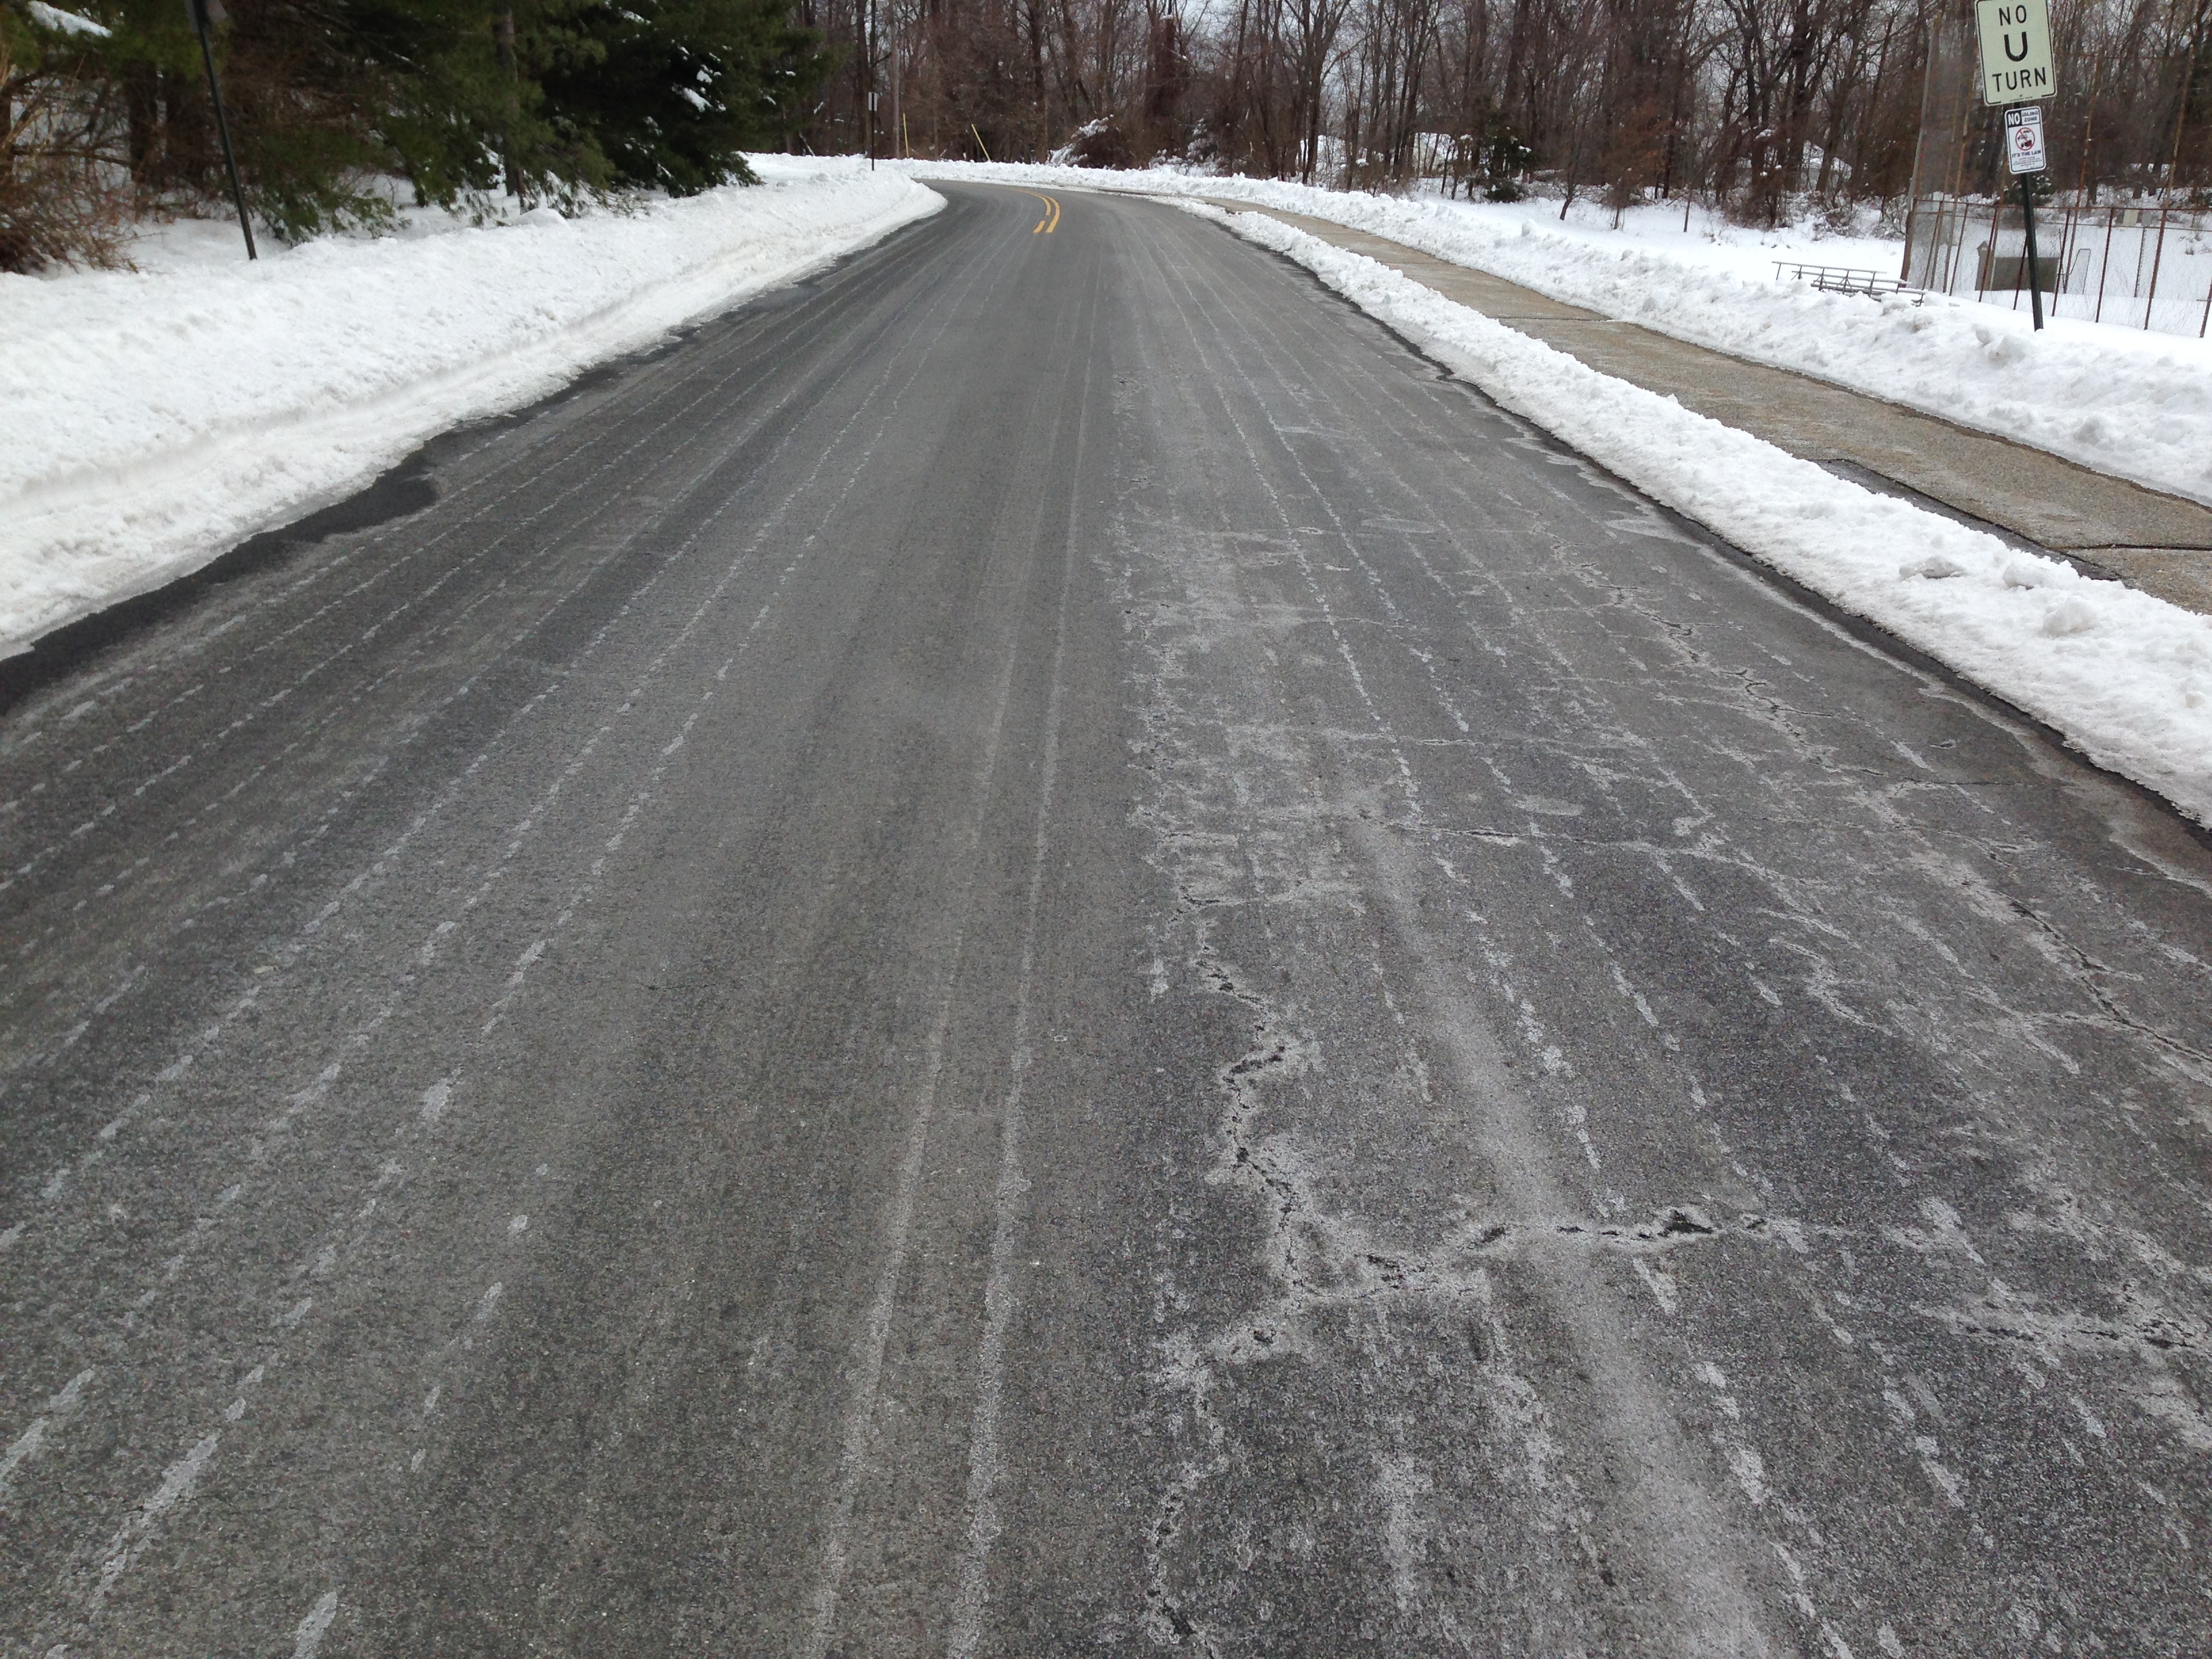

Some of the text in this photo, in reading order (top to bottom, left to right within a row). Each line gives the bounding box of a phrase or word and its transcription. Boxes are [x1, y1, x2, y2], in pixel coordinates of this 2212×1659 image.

[1999, 5, 2026, 26] NO
[2004, 31, 2028, 62] U
[1992, 66, 2046, 92] TURN
[2008, 112, 2020, 126] NO
